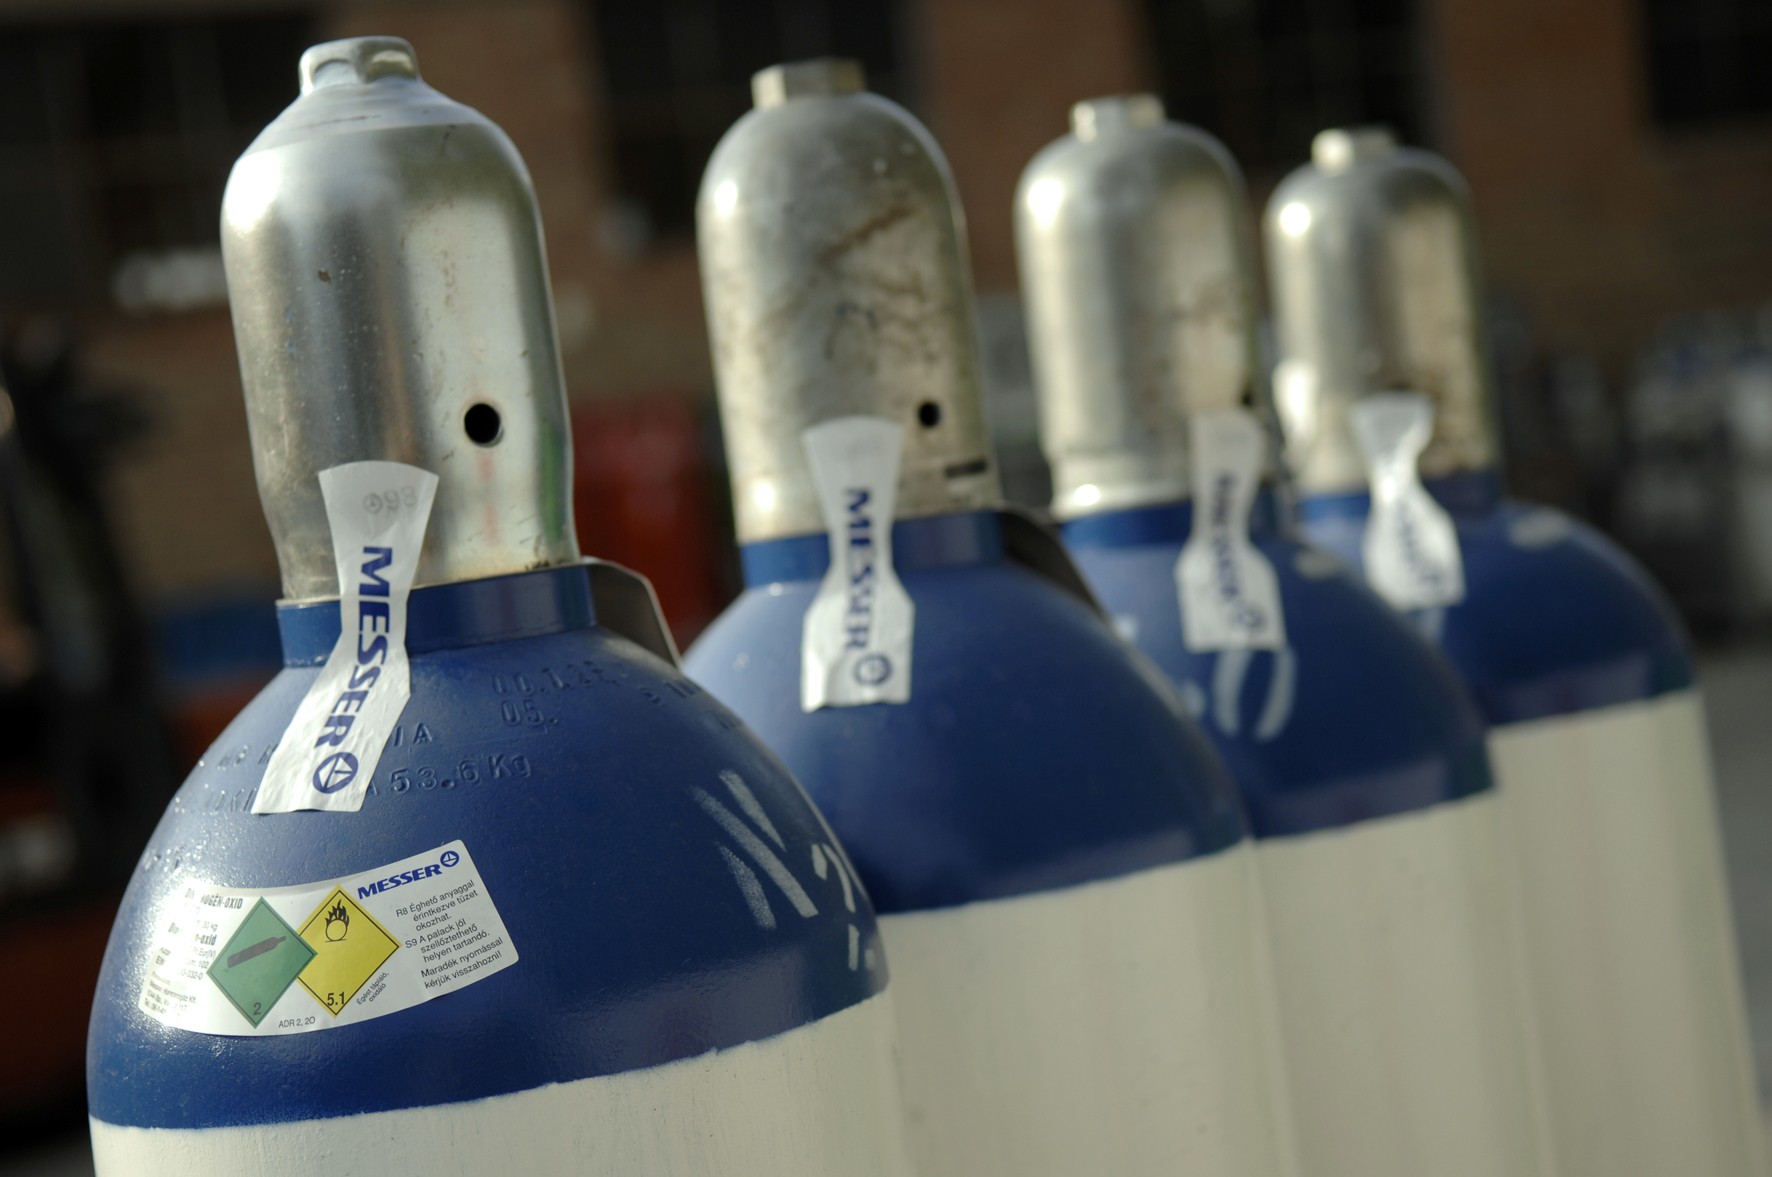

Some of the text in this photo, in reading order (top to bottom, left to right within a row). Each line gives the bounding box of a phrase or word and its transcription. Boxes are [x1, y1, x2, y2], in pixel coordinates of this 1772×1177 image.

[314, 546, 393, 749] MESSER
[357, 864, 443, 899] MESSER
[396, 880, 475, 918] R8 Éghető anyaggal
[413, 890, 479, 922] érintkezve tüzet
[405, 918, 467, 949] S9 A palack jól
[416, 913, 452, 932] okozhat.
[420, 937, 503, 978] Maradék nyomással
[423, 931, 490, 963] helyen tartandó.
[424, 951, 503, 989] kérjük visszahozni!
[253, 1002, 262, 1016] 2
[327, 991, 345, 1007] 5.1
[278, 1019, 295, 1029] ADR
